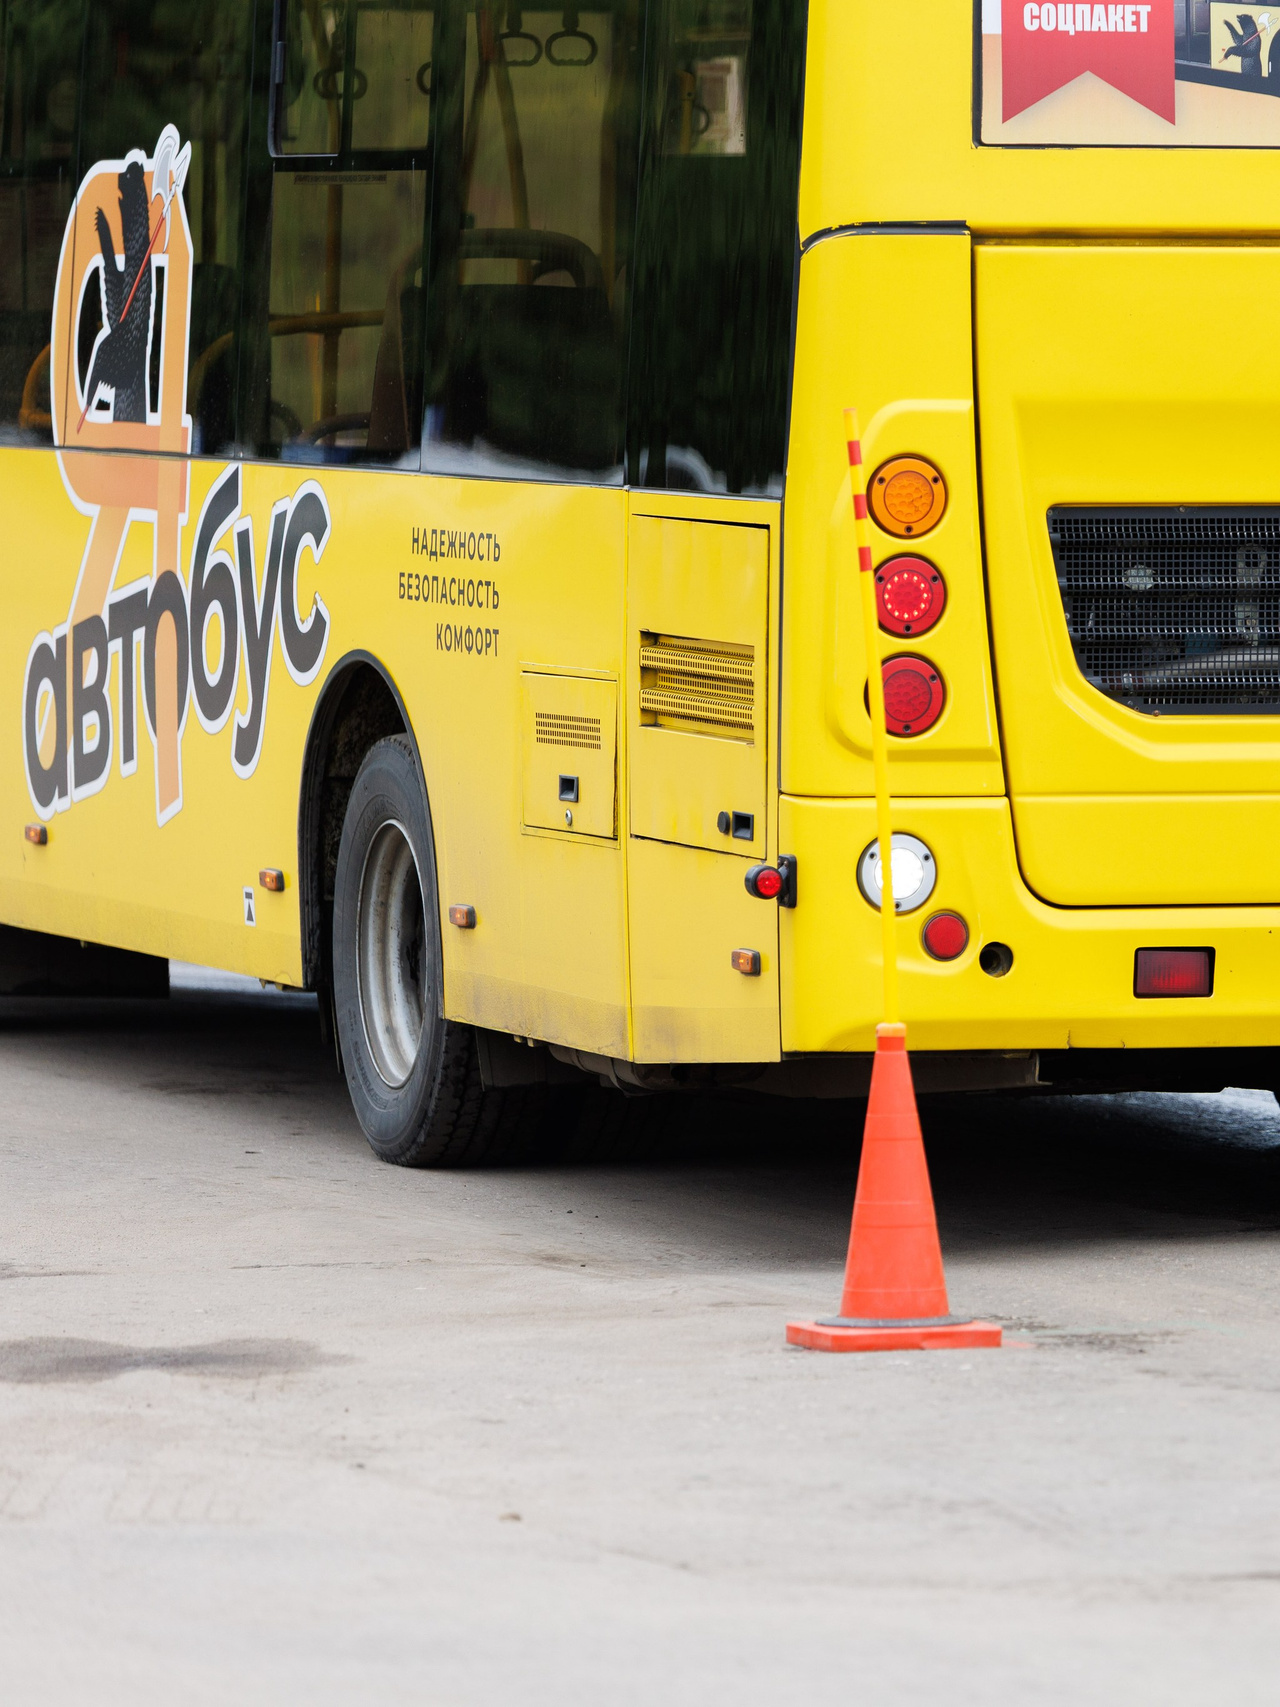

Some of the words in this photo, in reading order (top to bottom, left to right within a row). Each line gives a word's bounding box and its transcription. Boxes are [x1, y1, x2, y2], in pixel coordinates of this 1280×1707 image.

[1023, 2, 1151, 36] СОЦПАКЕТ
[411, 526, 501, 562] НАДЕЖНОСТЬ
[398, 571, 500, 610] БЕЗОПАСНОСТЬ
[436, 622, 499, 657] КОМФОРТ
